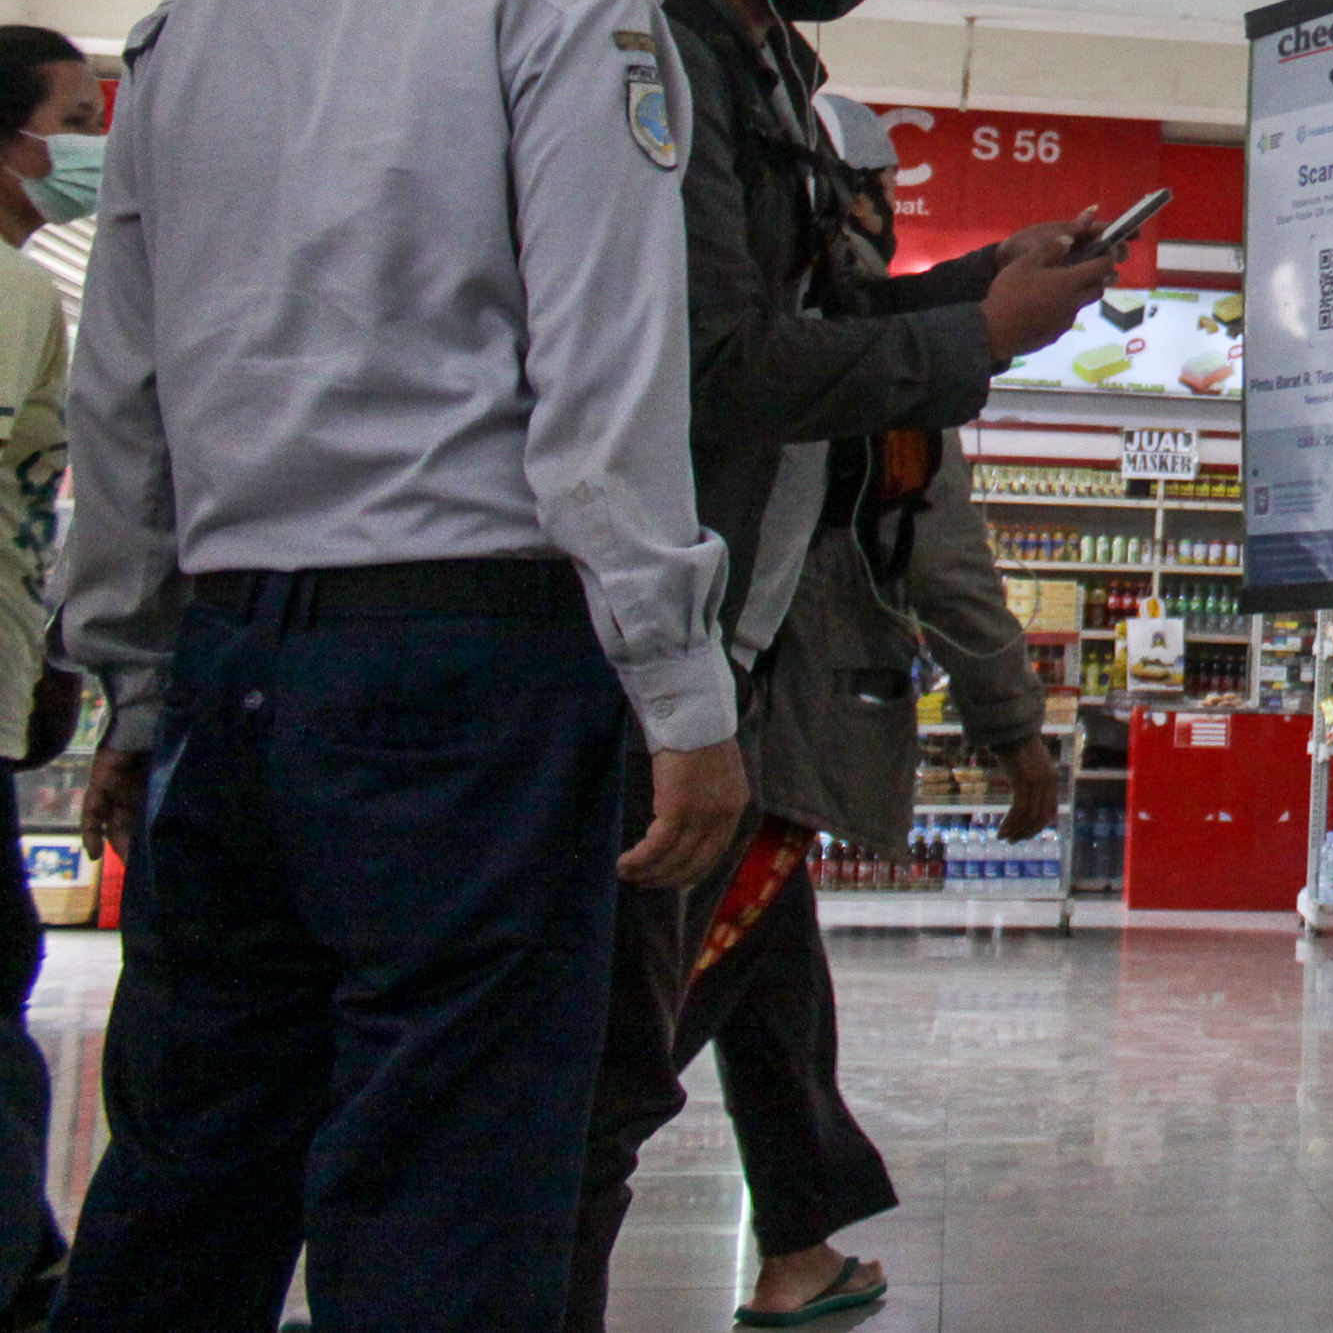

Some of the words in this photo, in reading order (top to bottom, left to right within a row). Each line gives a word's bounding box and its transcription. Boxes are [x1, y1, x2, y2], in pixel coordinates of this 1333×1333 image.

[971, 126, 1001, 161] S
[1013, 129, 1062, 164] 56
[1125, 430, 1192, 452] JUAL
[1124, 453, 1193, 475] MASKER
